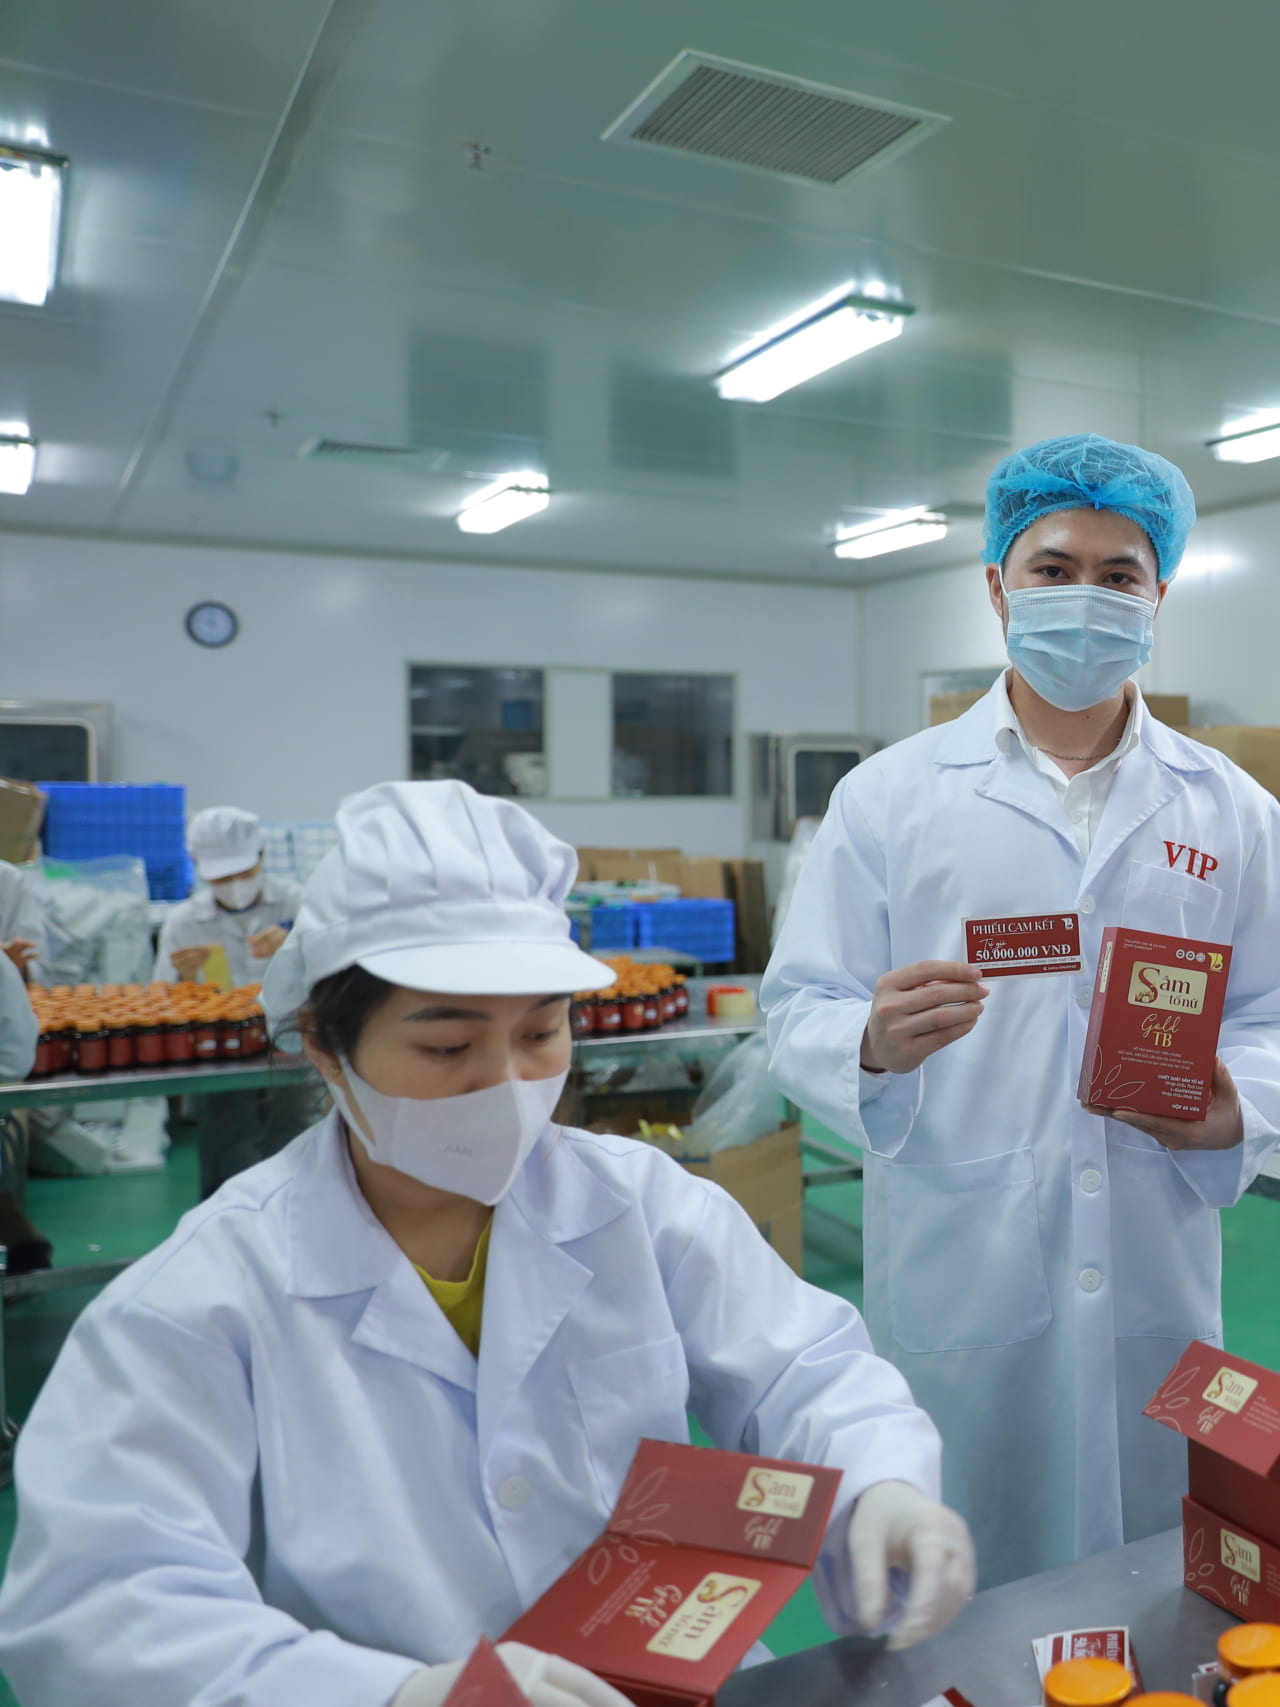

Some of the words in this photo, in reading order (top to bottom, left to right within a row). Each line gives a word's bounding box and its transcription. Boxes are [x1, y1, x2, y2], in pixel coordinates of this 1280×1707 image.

[1163, 840, 1218, 881] VIP
[972, 921, 1006, 935] PHIẾU
[1008, 922, 1032, 933] CAM
[1035, 918, 1055, 931] KẾT
[976, 946, 1039, 961] 50.000.000
[1041, 944, 1072, 956] VNĐ
[1135, 967, 1190, 1003] Sâm
[1141, 1013, 1181, 1038] Gold
[1154, 1031, 1172, 1048] TB
